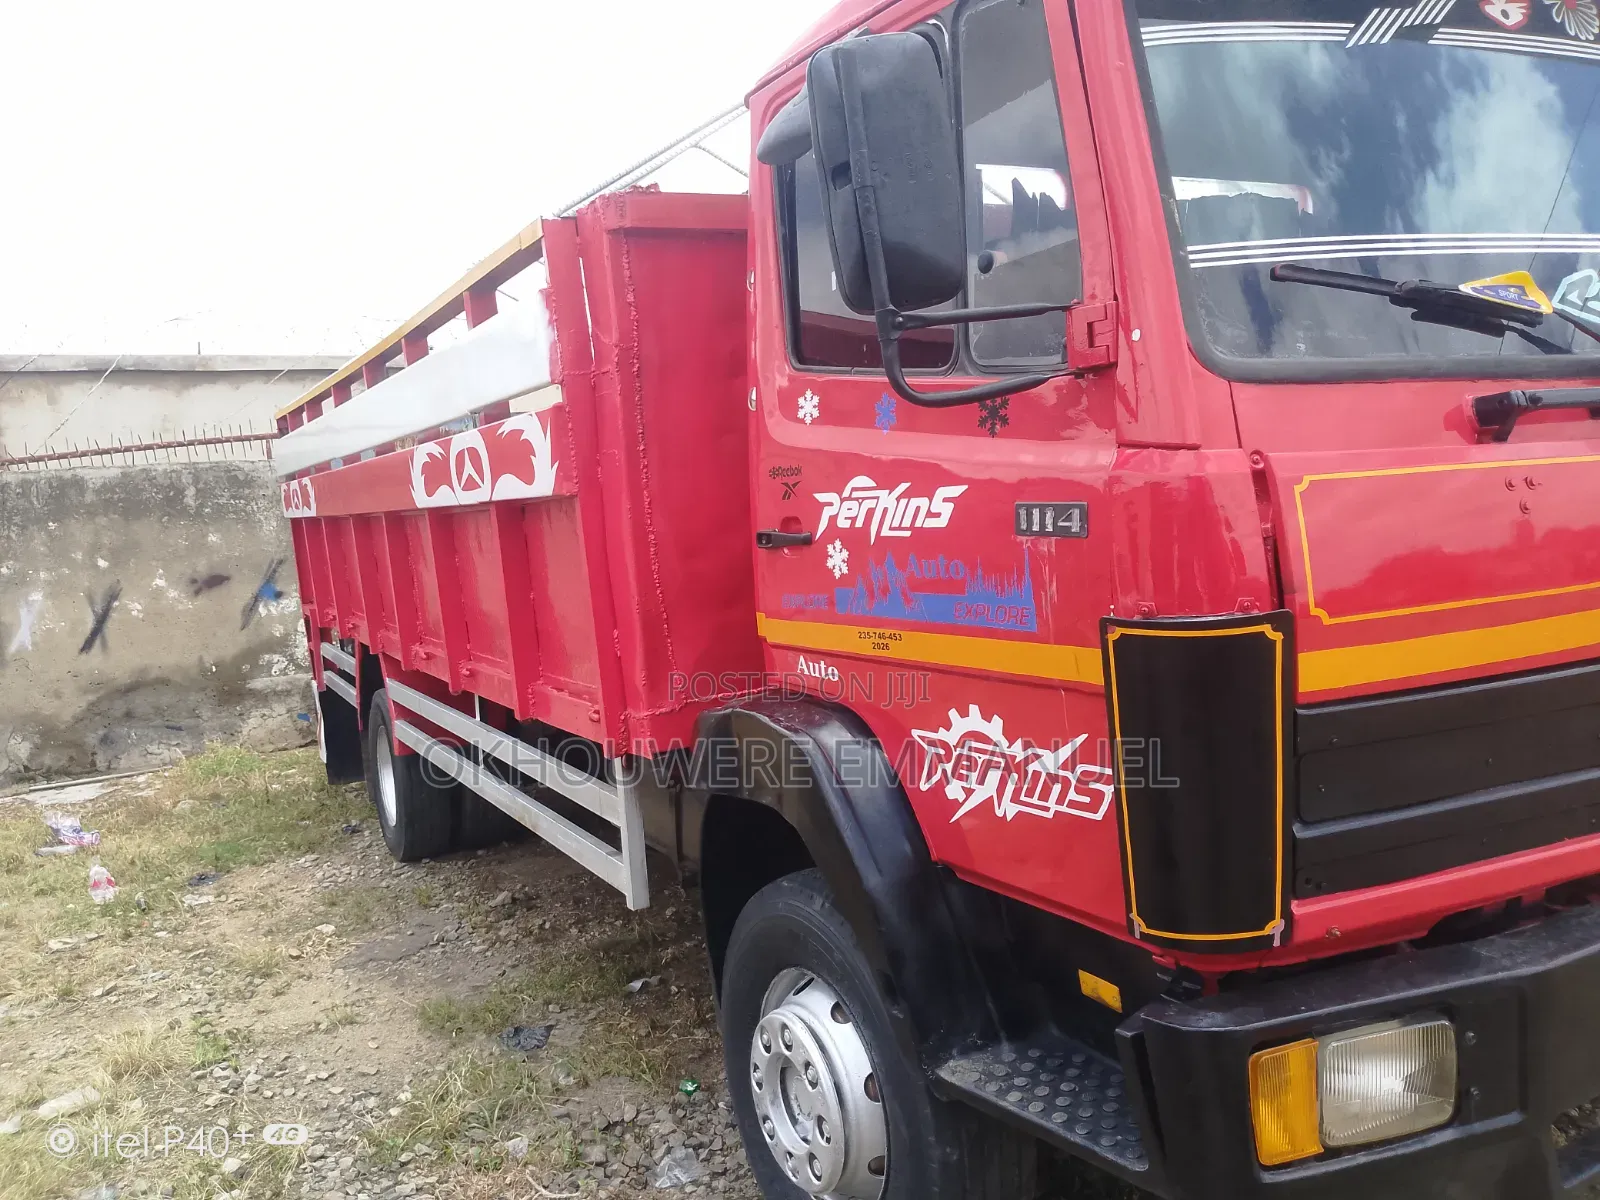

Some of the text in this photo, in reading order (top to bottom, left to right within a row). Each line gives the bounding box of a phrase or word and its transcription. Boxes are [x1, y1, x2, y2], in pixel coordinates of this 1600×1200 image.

[1498, 289, 1519, 300] SPORT
[1018, 506, 1081, 532] 1114
[904, 552, 966, 580] Auto
[953, 600, 1032, 627] EXPLORE
[857, 630, 903, 642] 235-746-453
[871, 641, 891, 651] 2026
[796, 654, 840, 682] Auto
